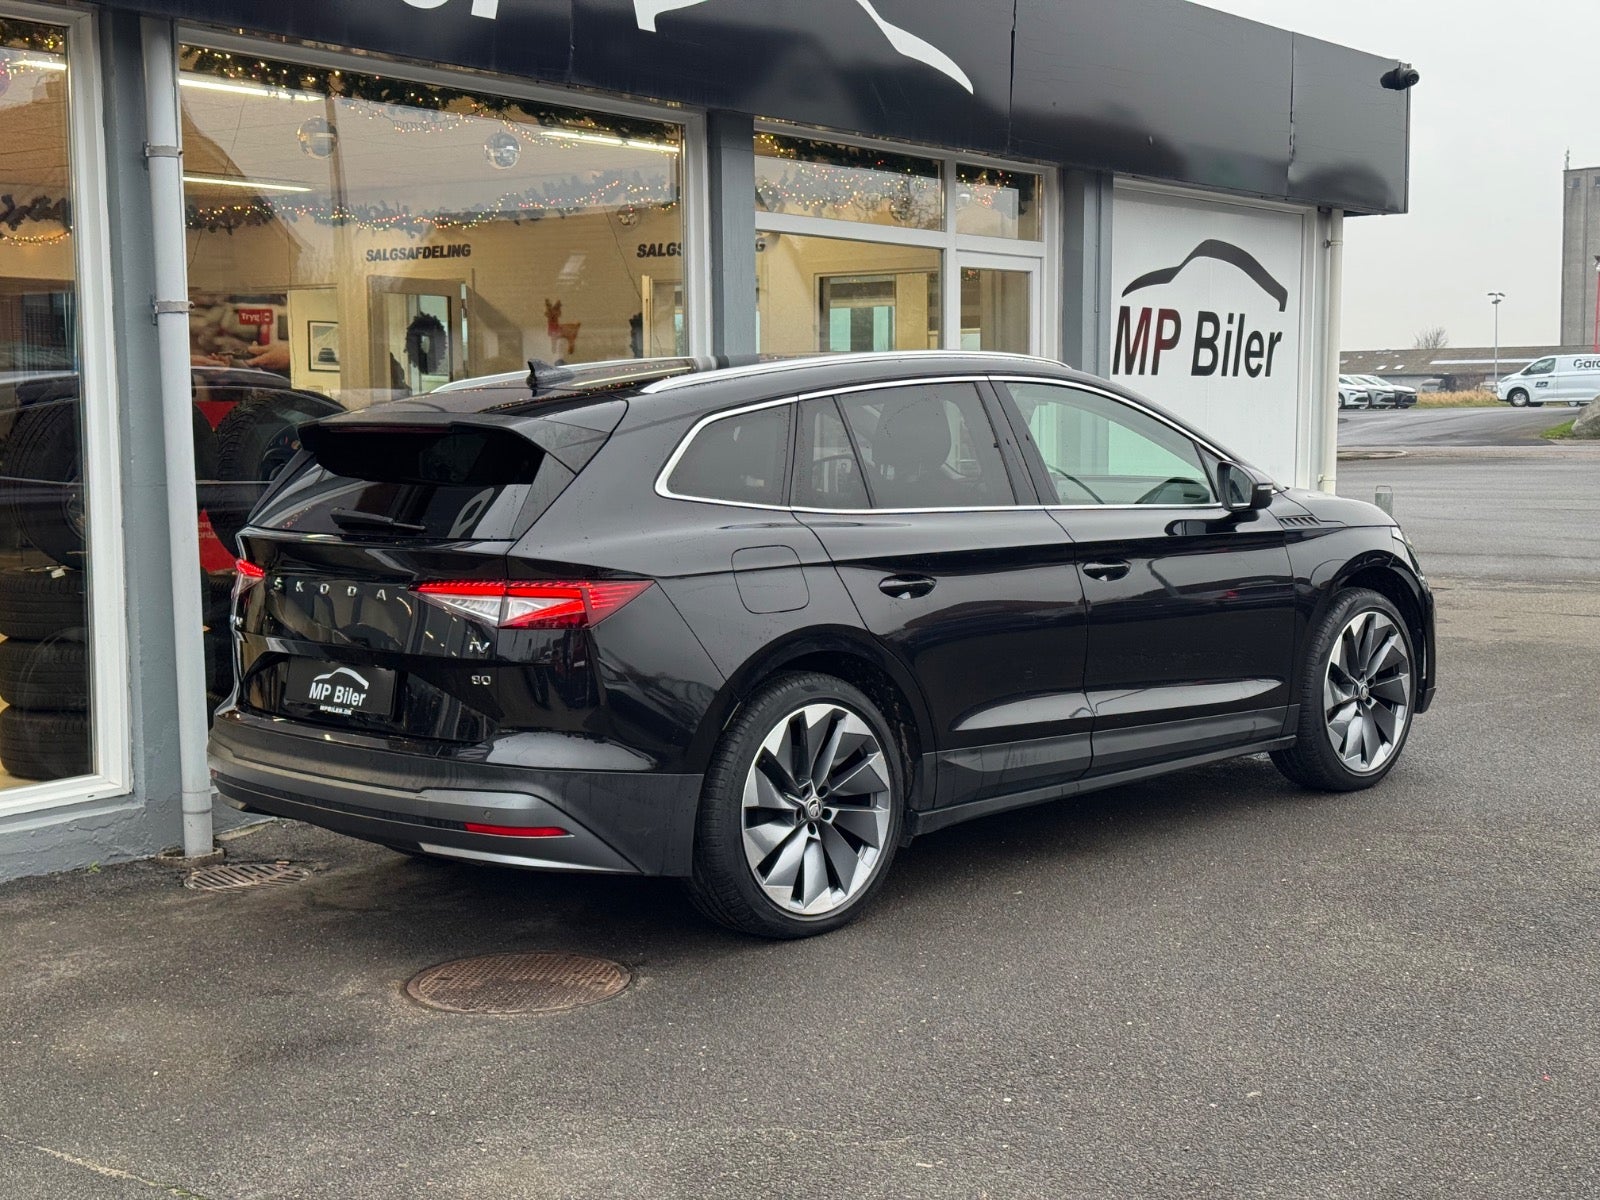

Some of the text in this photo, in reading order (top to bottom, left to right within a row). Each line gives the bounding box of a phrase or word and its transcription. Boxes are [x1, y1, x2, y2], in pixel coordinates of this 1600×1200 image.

[366, 243, 471, 262] SALGSAFDELING
[1112, 305, 1283, 378] MP Biler
[309, 682, 366, 706] MP Biler
